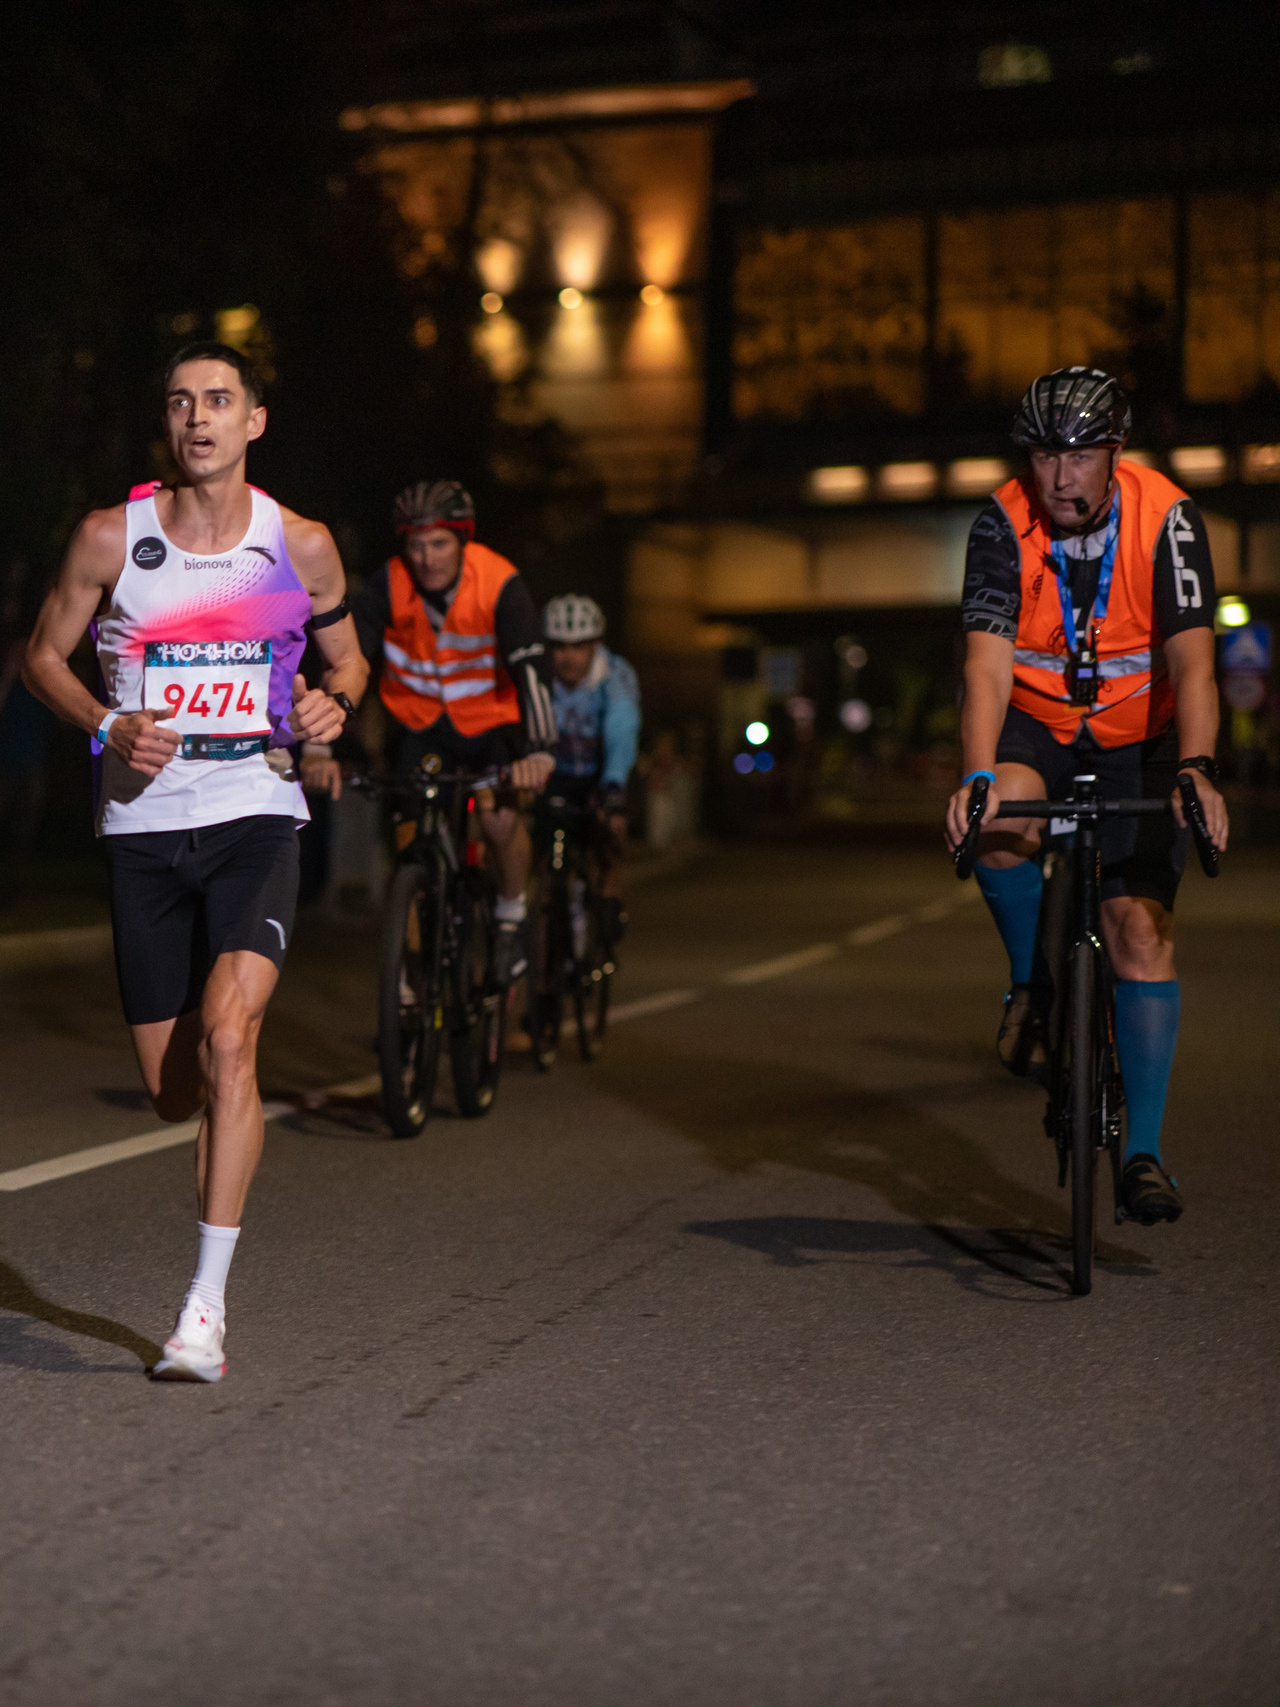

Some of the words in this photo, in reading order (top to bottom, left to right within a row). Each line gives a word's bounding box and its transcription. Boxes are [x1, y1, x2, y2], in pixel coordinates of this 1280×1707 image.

[184, 558, 232, 570] bionova
[157, 641, 263, 662] НОЧНОЙ
[163, 680, 255, 719] 9474
